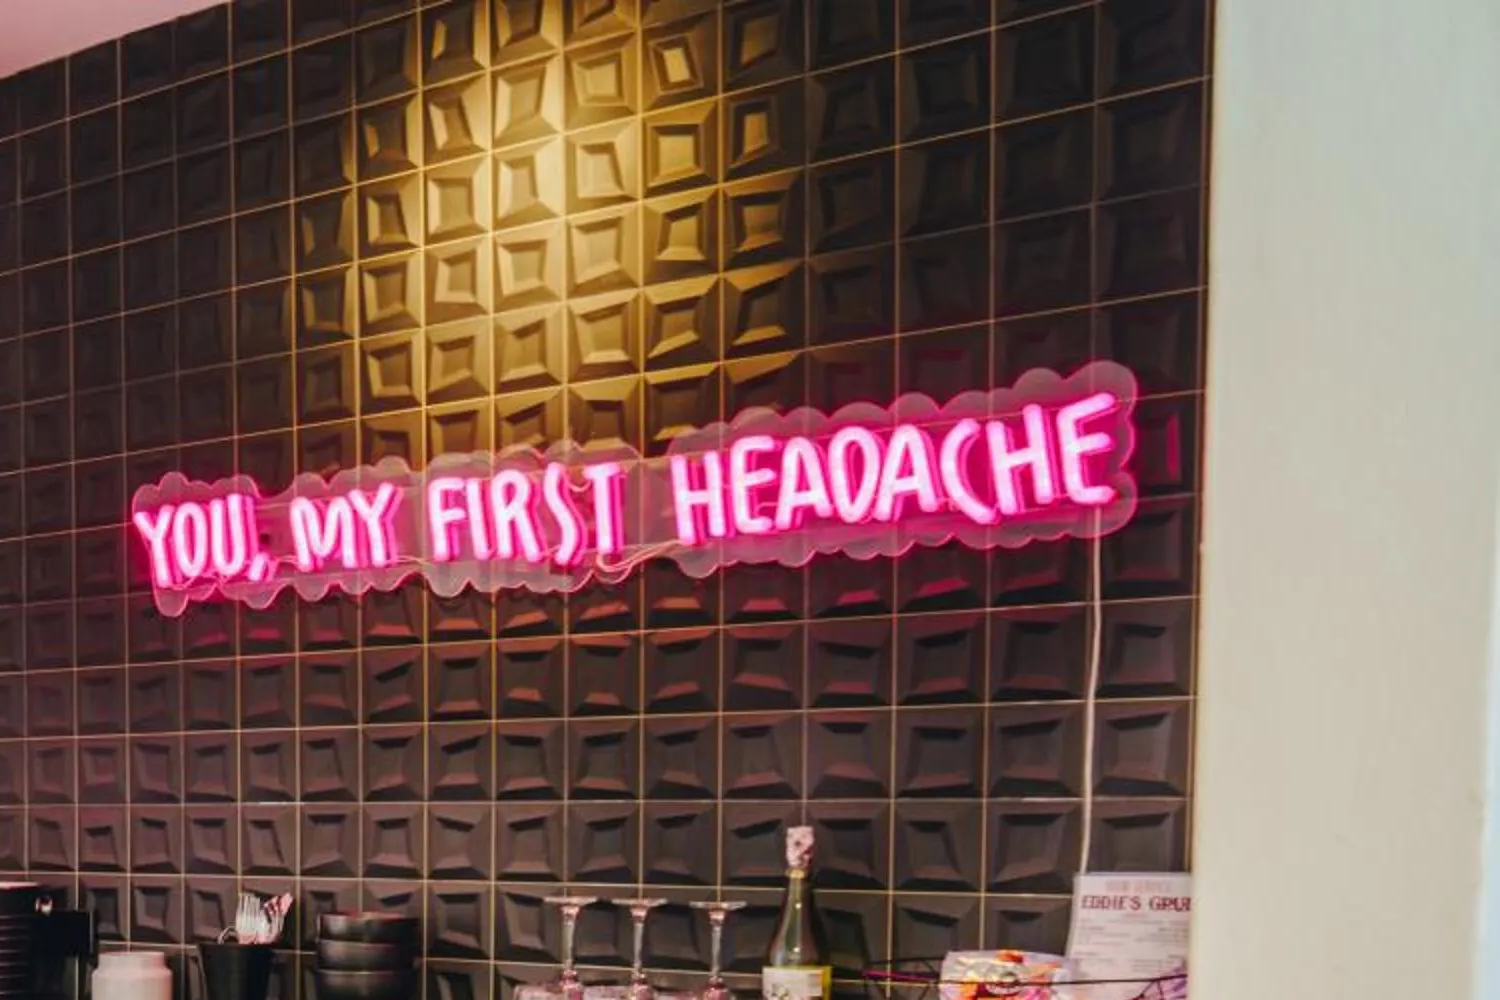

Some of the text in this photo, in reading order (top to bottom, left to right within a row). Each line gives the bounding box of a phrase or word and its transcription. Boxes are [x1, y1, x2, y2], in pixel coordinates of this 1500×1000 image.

[135, 391, 1117, 588] YOU, MY FIRST HEADACHE
